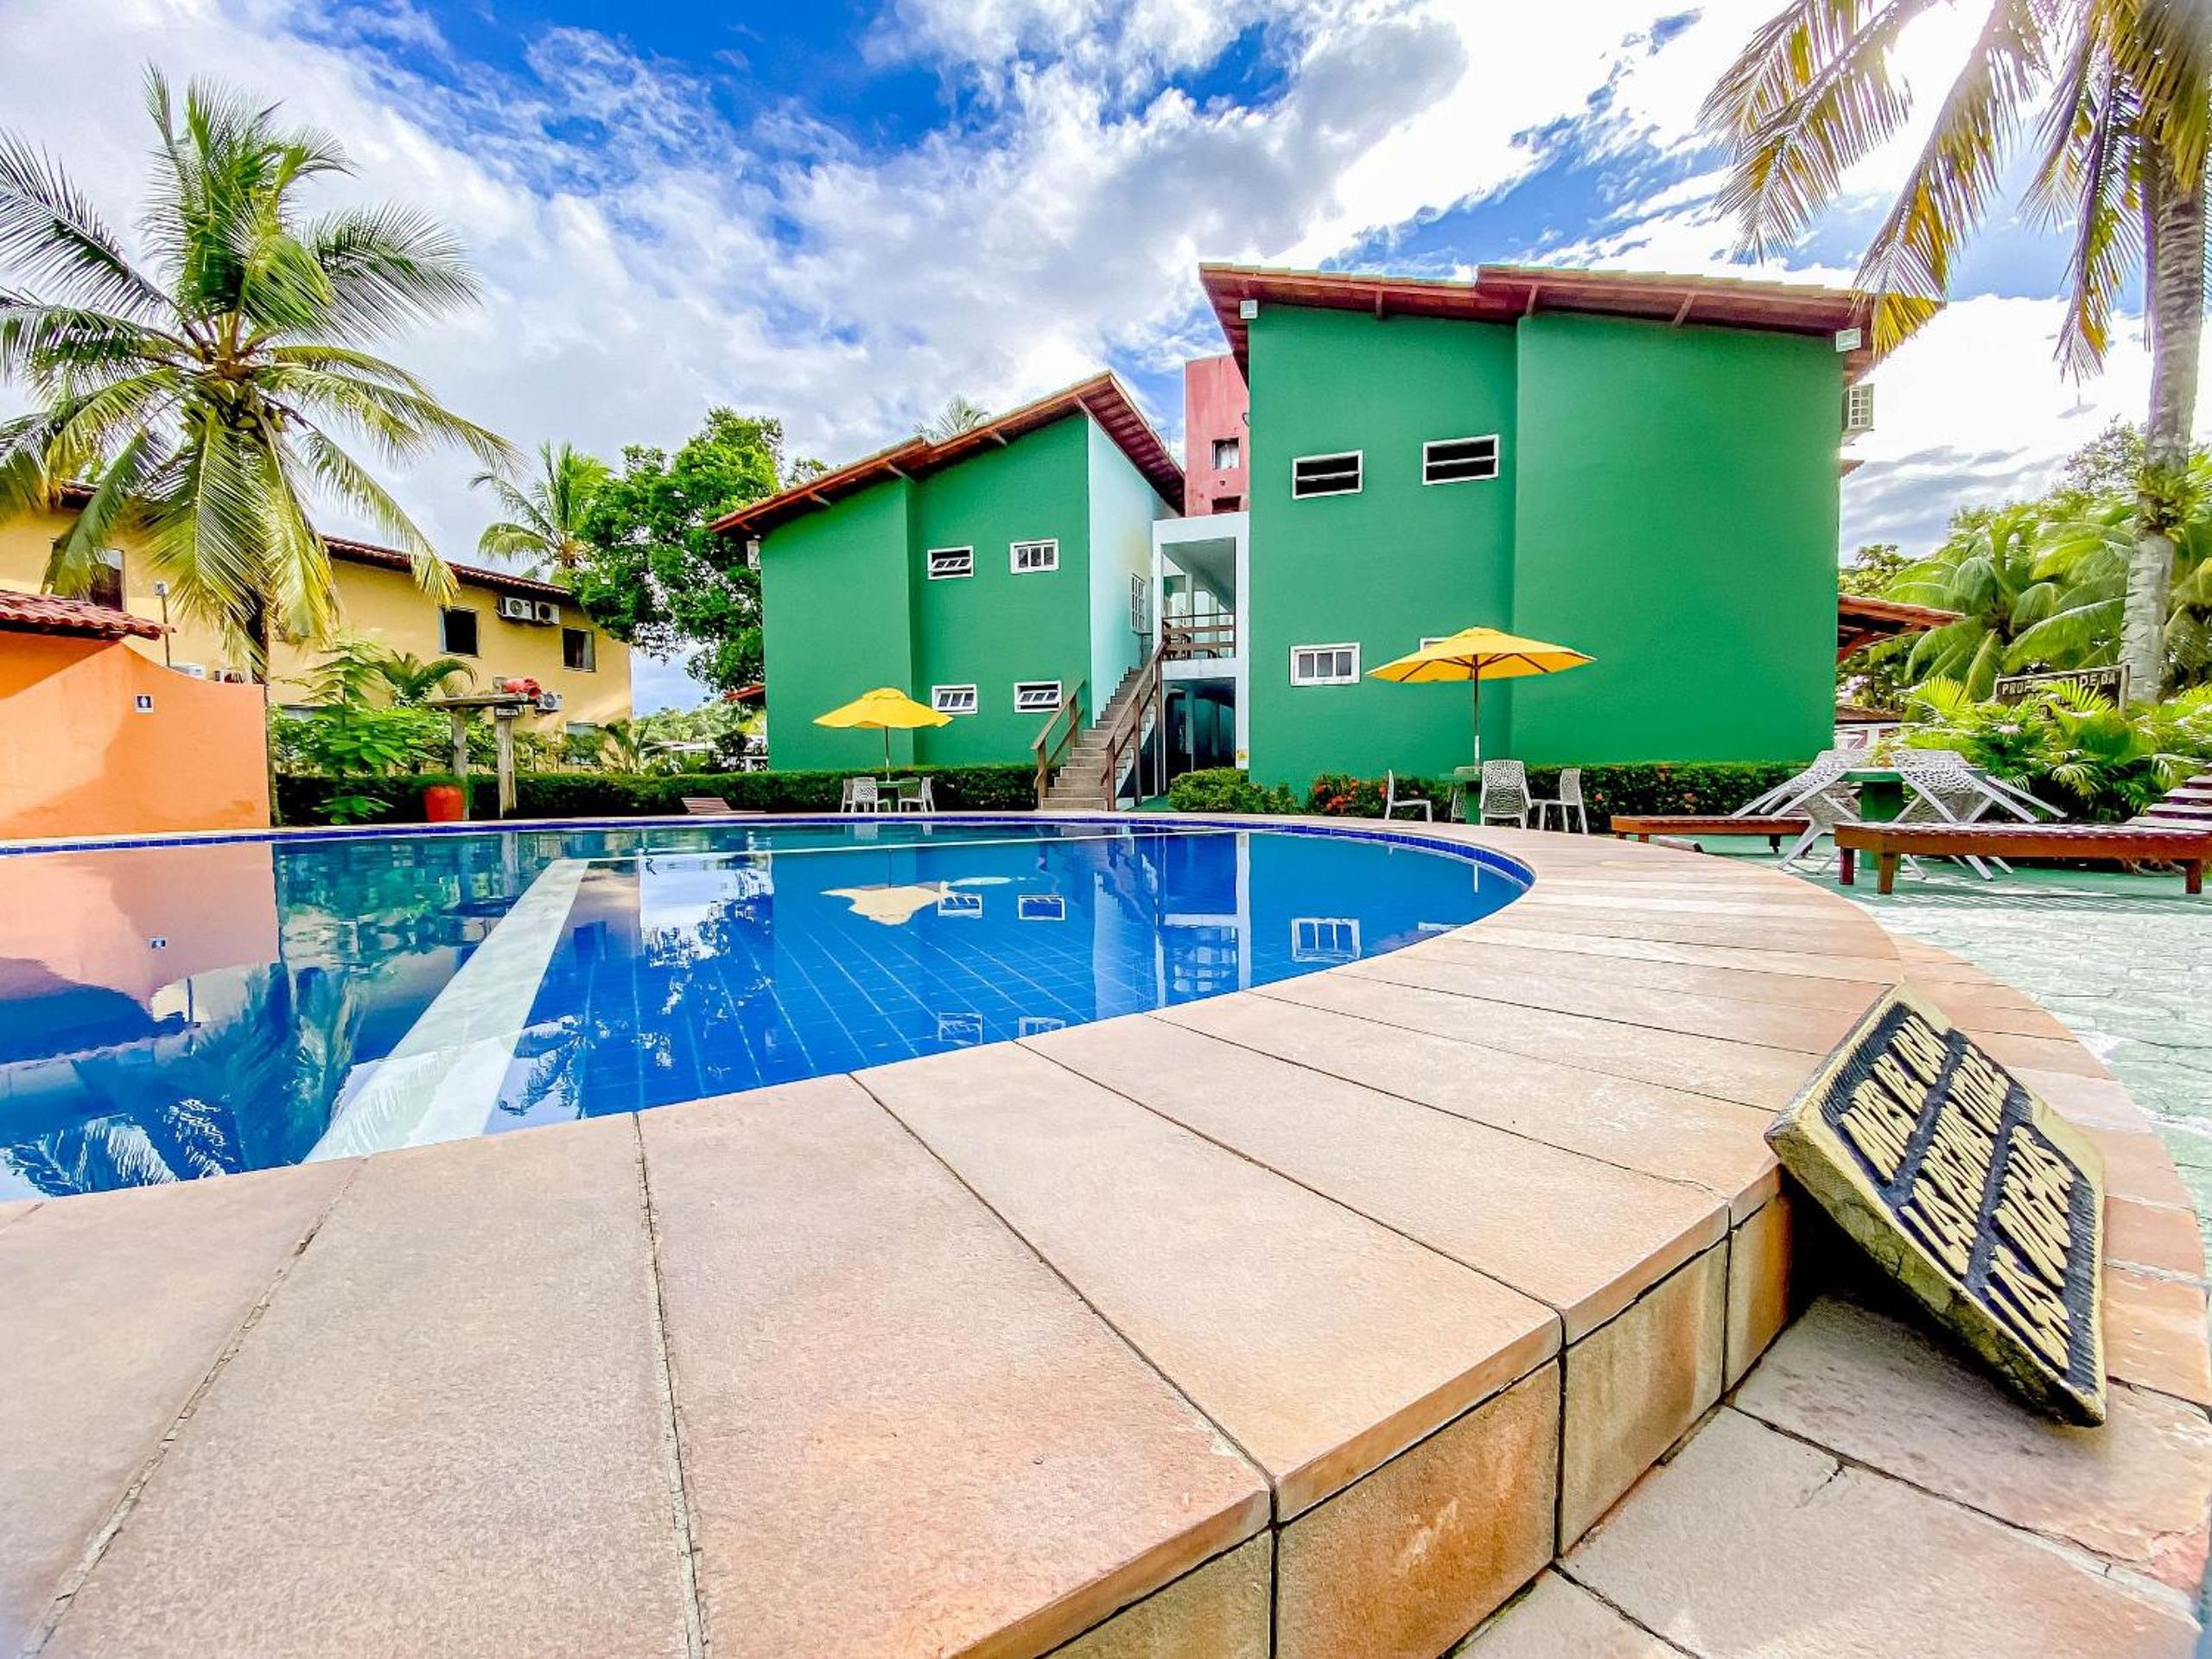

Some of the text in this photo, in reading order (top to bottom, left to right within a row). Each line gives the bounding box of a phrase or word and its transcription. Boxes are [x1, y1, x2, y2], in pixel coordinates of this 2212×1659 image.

[1841, 1015, 1949, 1180] ANTES DEL USAR
[1901, 1044, 2009, 1274] LAS PISCINAS UTILIZE
[1986, 1125, 2074, 1370] LAS DUCHAS
